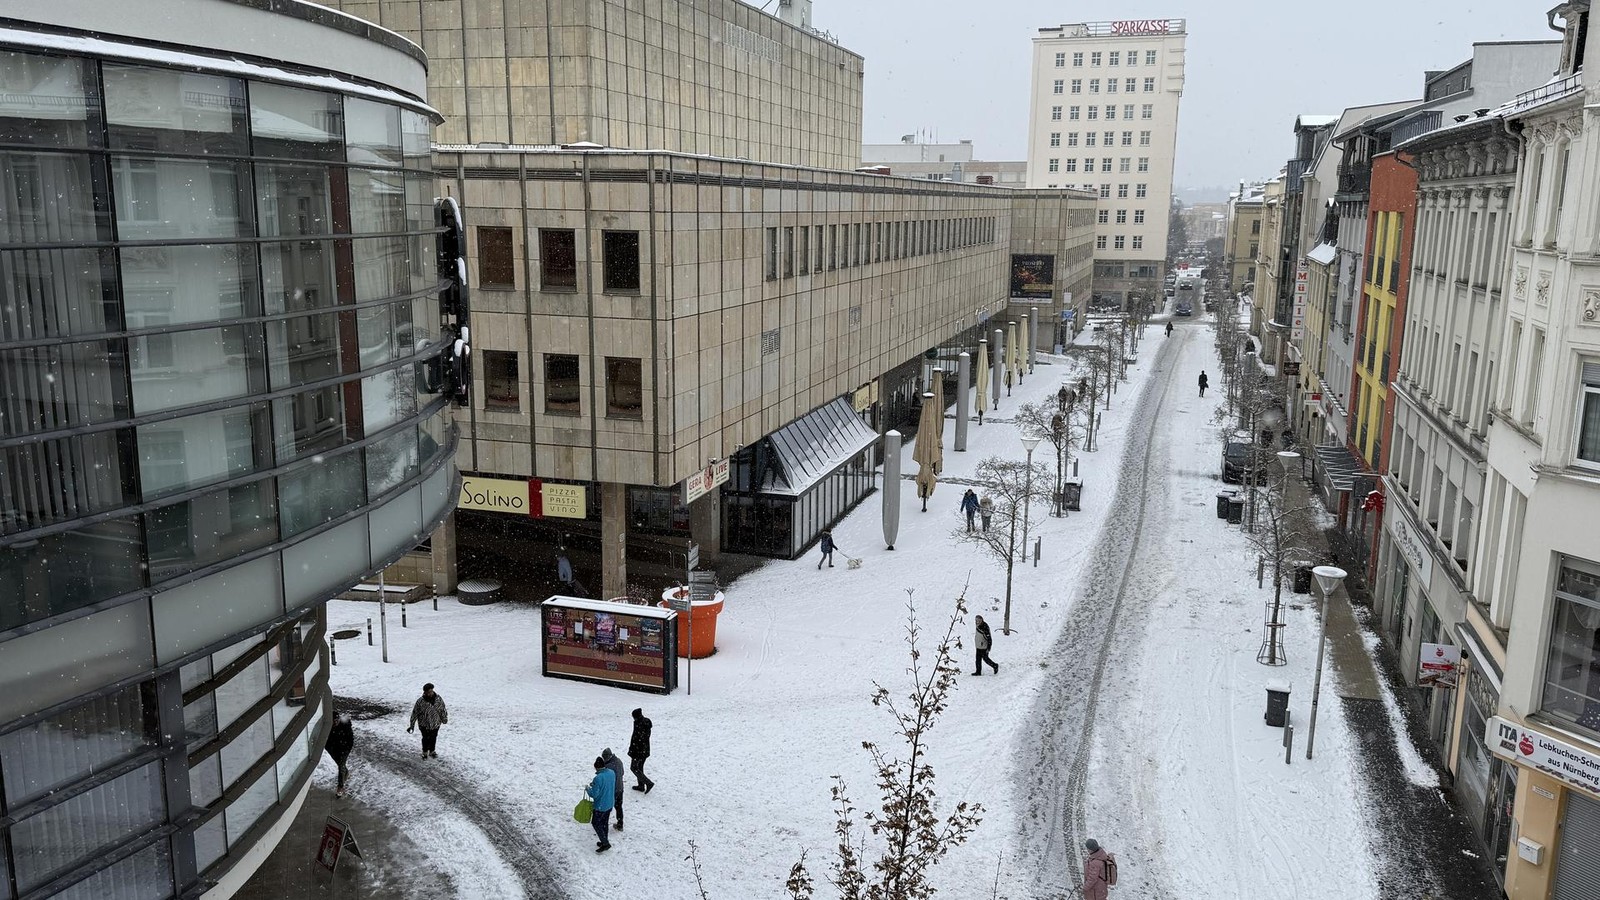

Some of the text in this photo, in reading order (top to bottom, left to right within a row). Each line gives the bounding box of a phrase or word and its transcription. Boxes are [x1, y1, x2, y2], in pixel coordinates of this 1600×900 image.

[1111, 19, 1170, 34] SPARKASSE
[688, 476, 702, 491] GERA
[715, 462, 727, 476] LIVE
[549, 487, 576, 496] PIZZA
[549, 496, 577, 505] PASTA
[1499, 723, 1518, 743] ITA
[1547, 757, 1561, 768] aus
[1562, 761, 1600, 786] Nürnberg
